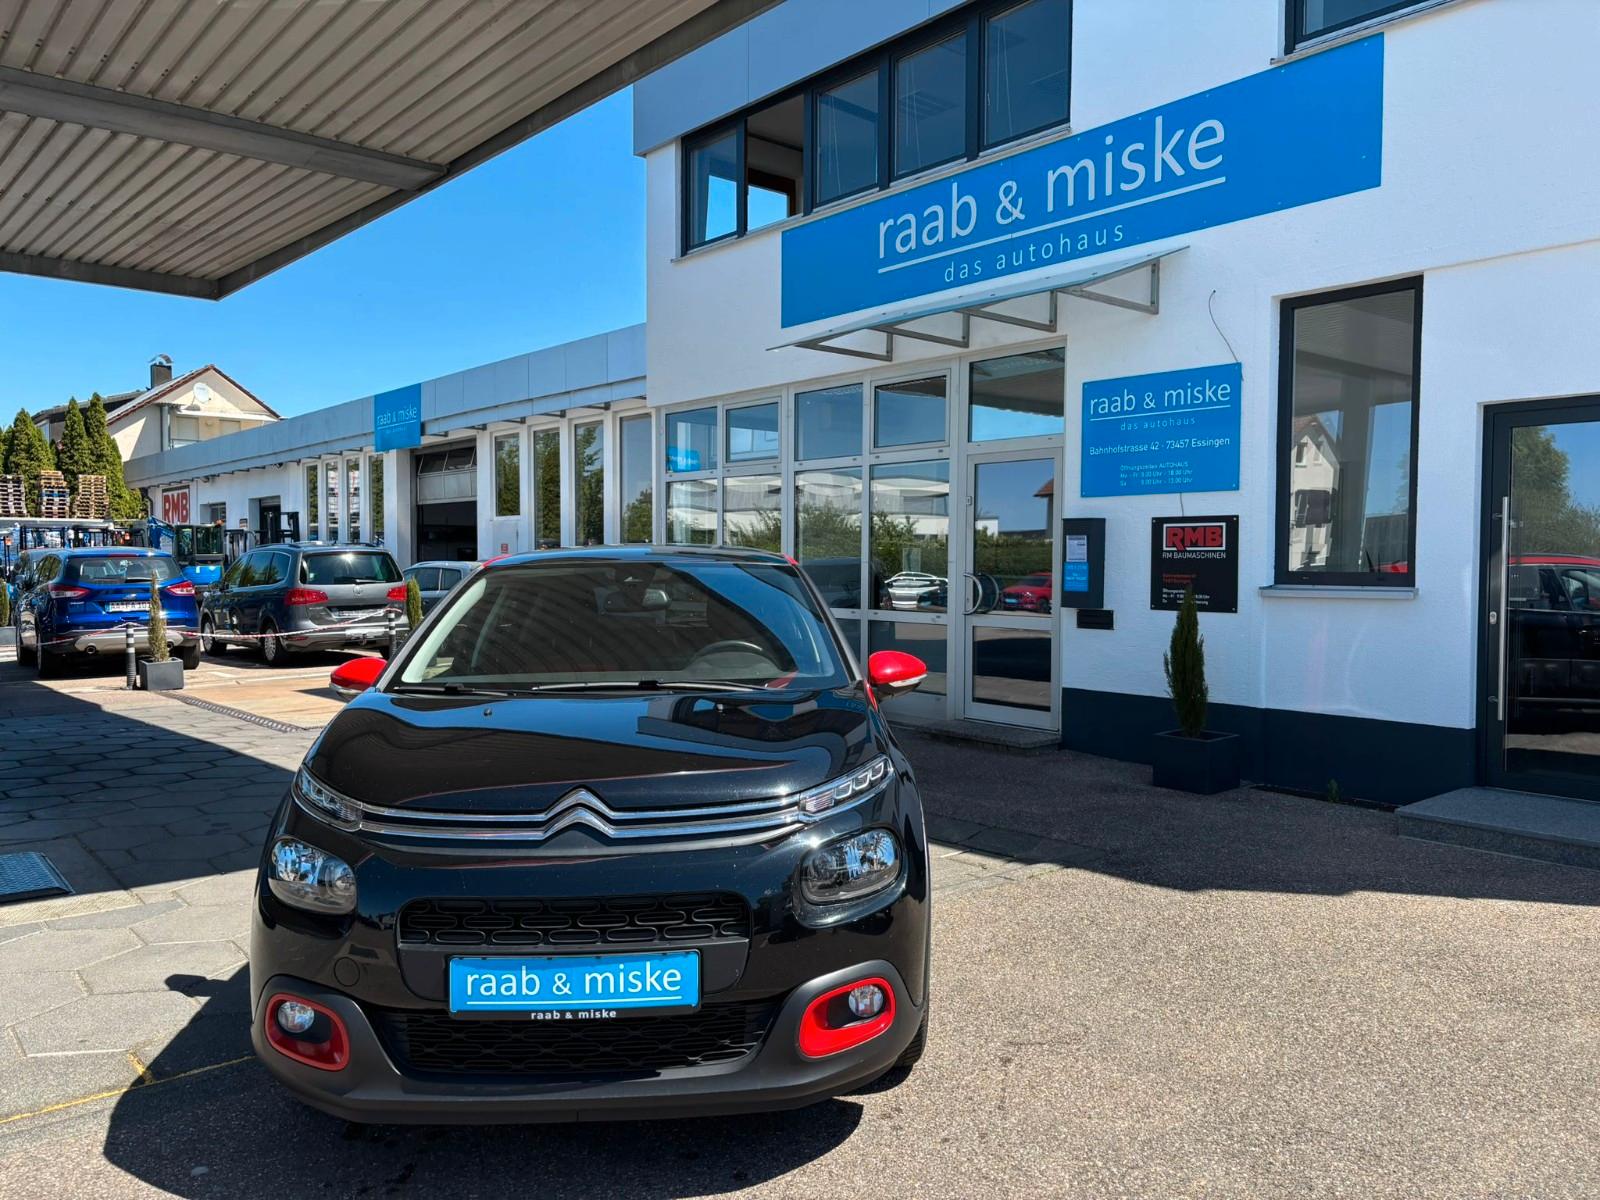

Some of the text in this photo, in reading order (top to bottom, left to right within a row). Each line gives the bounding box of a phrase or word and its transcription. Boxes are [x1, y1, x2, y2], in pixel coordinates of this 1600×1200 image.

[878, 115, 1225, 259] raab & miske
[944, 224, 1124, 283] das autohaus
[1090, 379, 1231, 415] raab & miske
[1120, 417, 1196, 431] das autohaus
[1089, 443, 1148, 455] Bahnhofstrasse
[1150, 441, 1160, 451] 42
[1166, 439, 1190, 449] 73457
[1191, 437, 1231, 449] Essingen
[163, 492, 188, 524] RMB
[1166, 526, 1222, 551] RMB
[1173, 551, 1226, 559] BAUMASCHINEN
[466, 961, 682, 996] raab & miske
[531, 1009, 617, 1020] raab & miske
